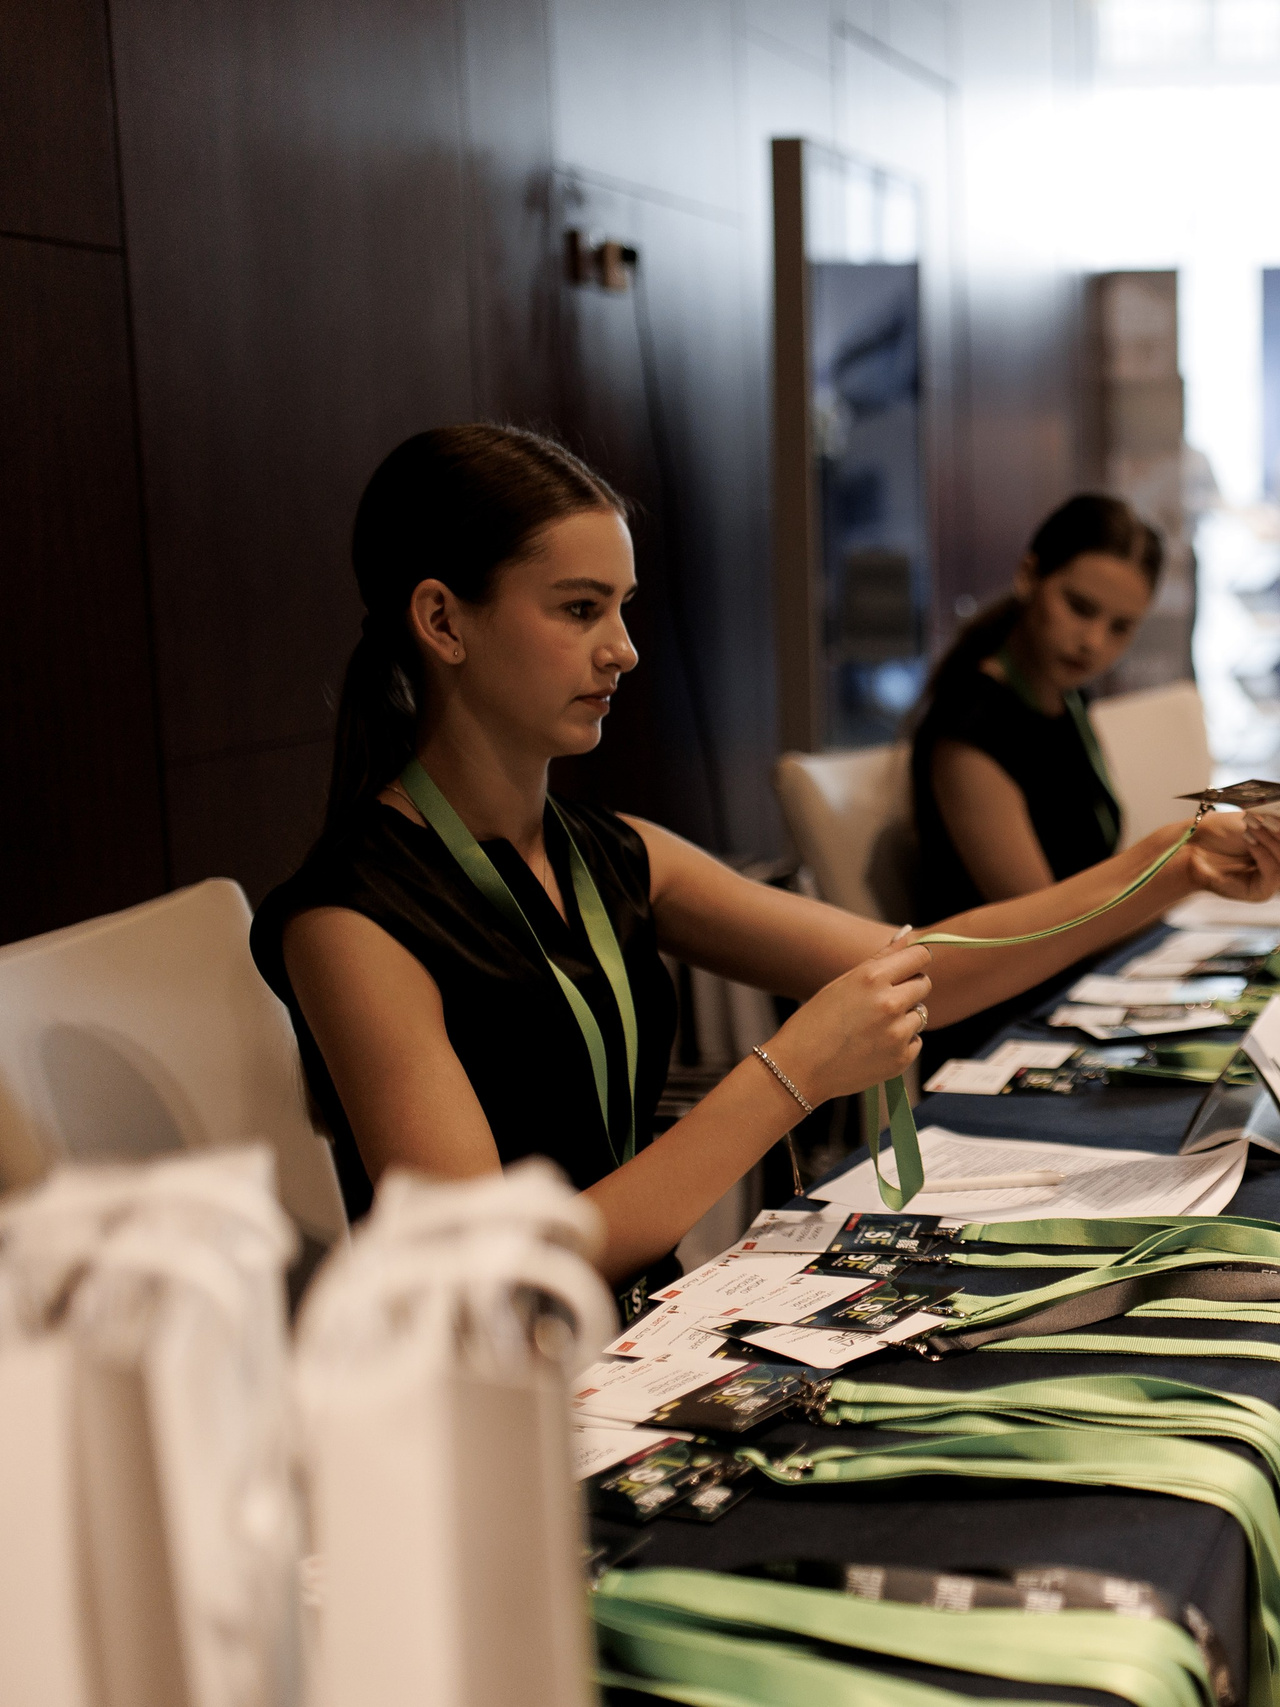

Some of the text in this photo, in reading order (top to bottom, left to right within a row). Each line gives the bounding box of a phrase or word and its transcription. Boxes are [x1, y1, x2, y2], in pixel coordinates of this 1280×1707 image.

[842, 1254, 876, 1269] SF
[726, 1274, 760, 1296] АЛЕКСАНДР
[845, 1296, 898, 1320] LSF
[647, 1370, 695, 1395] АЛЕКСАНДР
[711, 1379, 772, 1405] LSF
